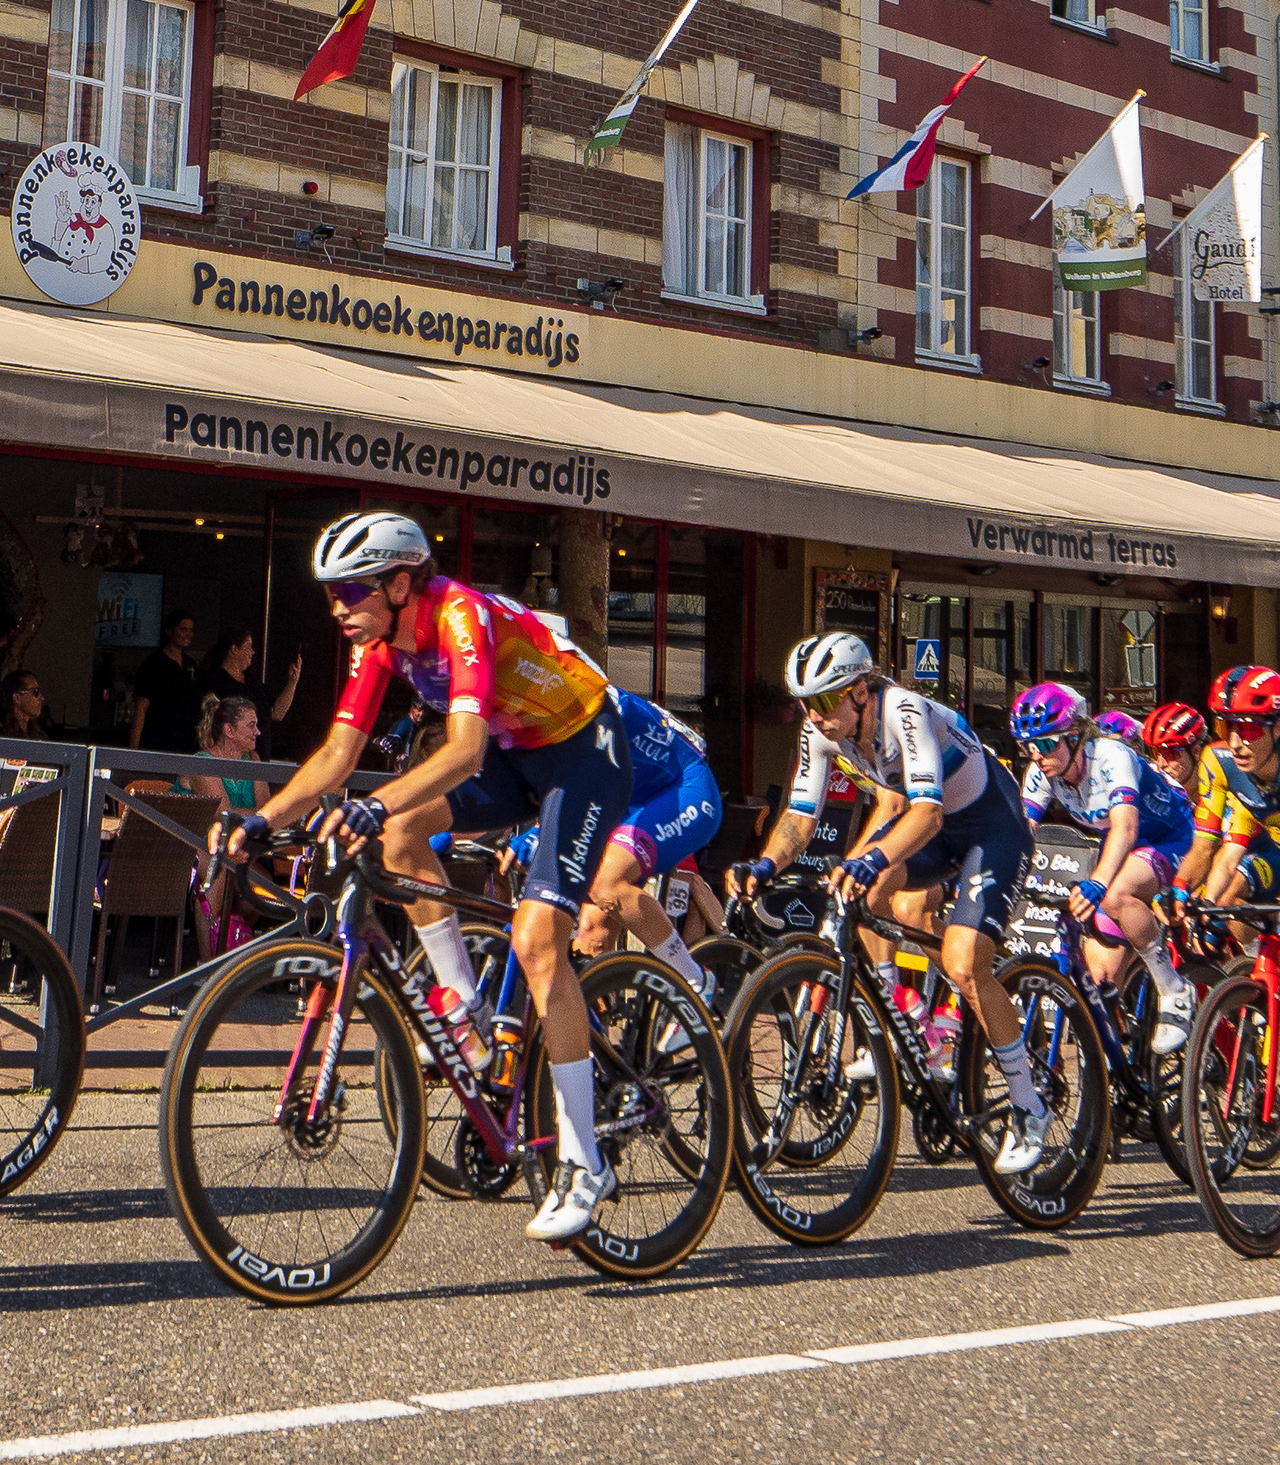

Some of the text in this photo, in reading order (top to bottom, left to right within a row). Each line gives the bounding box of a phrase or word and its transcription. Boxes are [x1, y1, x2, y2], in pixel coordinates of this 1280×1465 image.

[1208, 285, 1244, 300] Hotel
[191, 261, 581, 367] Pannenkoekenparadijs
[164, 402, 612, 506] Pannenkoekenparadijs
[967, 516, 1177, 569] Verwarmd terras
[573, 802, 603, 866] sdworx
[655, 804, 700, 842] Jayco
[812, 820, 839, 842] hte
[794, 850, 825, 872] nburg
[1050, 853, 1081, 874] Bike
[672, 888, 689, 911] 95
[1025, 874, 1071, 897] Parkin
[632, 969, 710, 1036] roval
[587, 1229, 640, 1262] rov
[226, 1244, 331, 1290] roval
